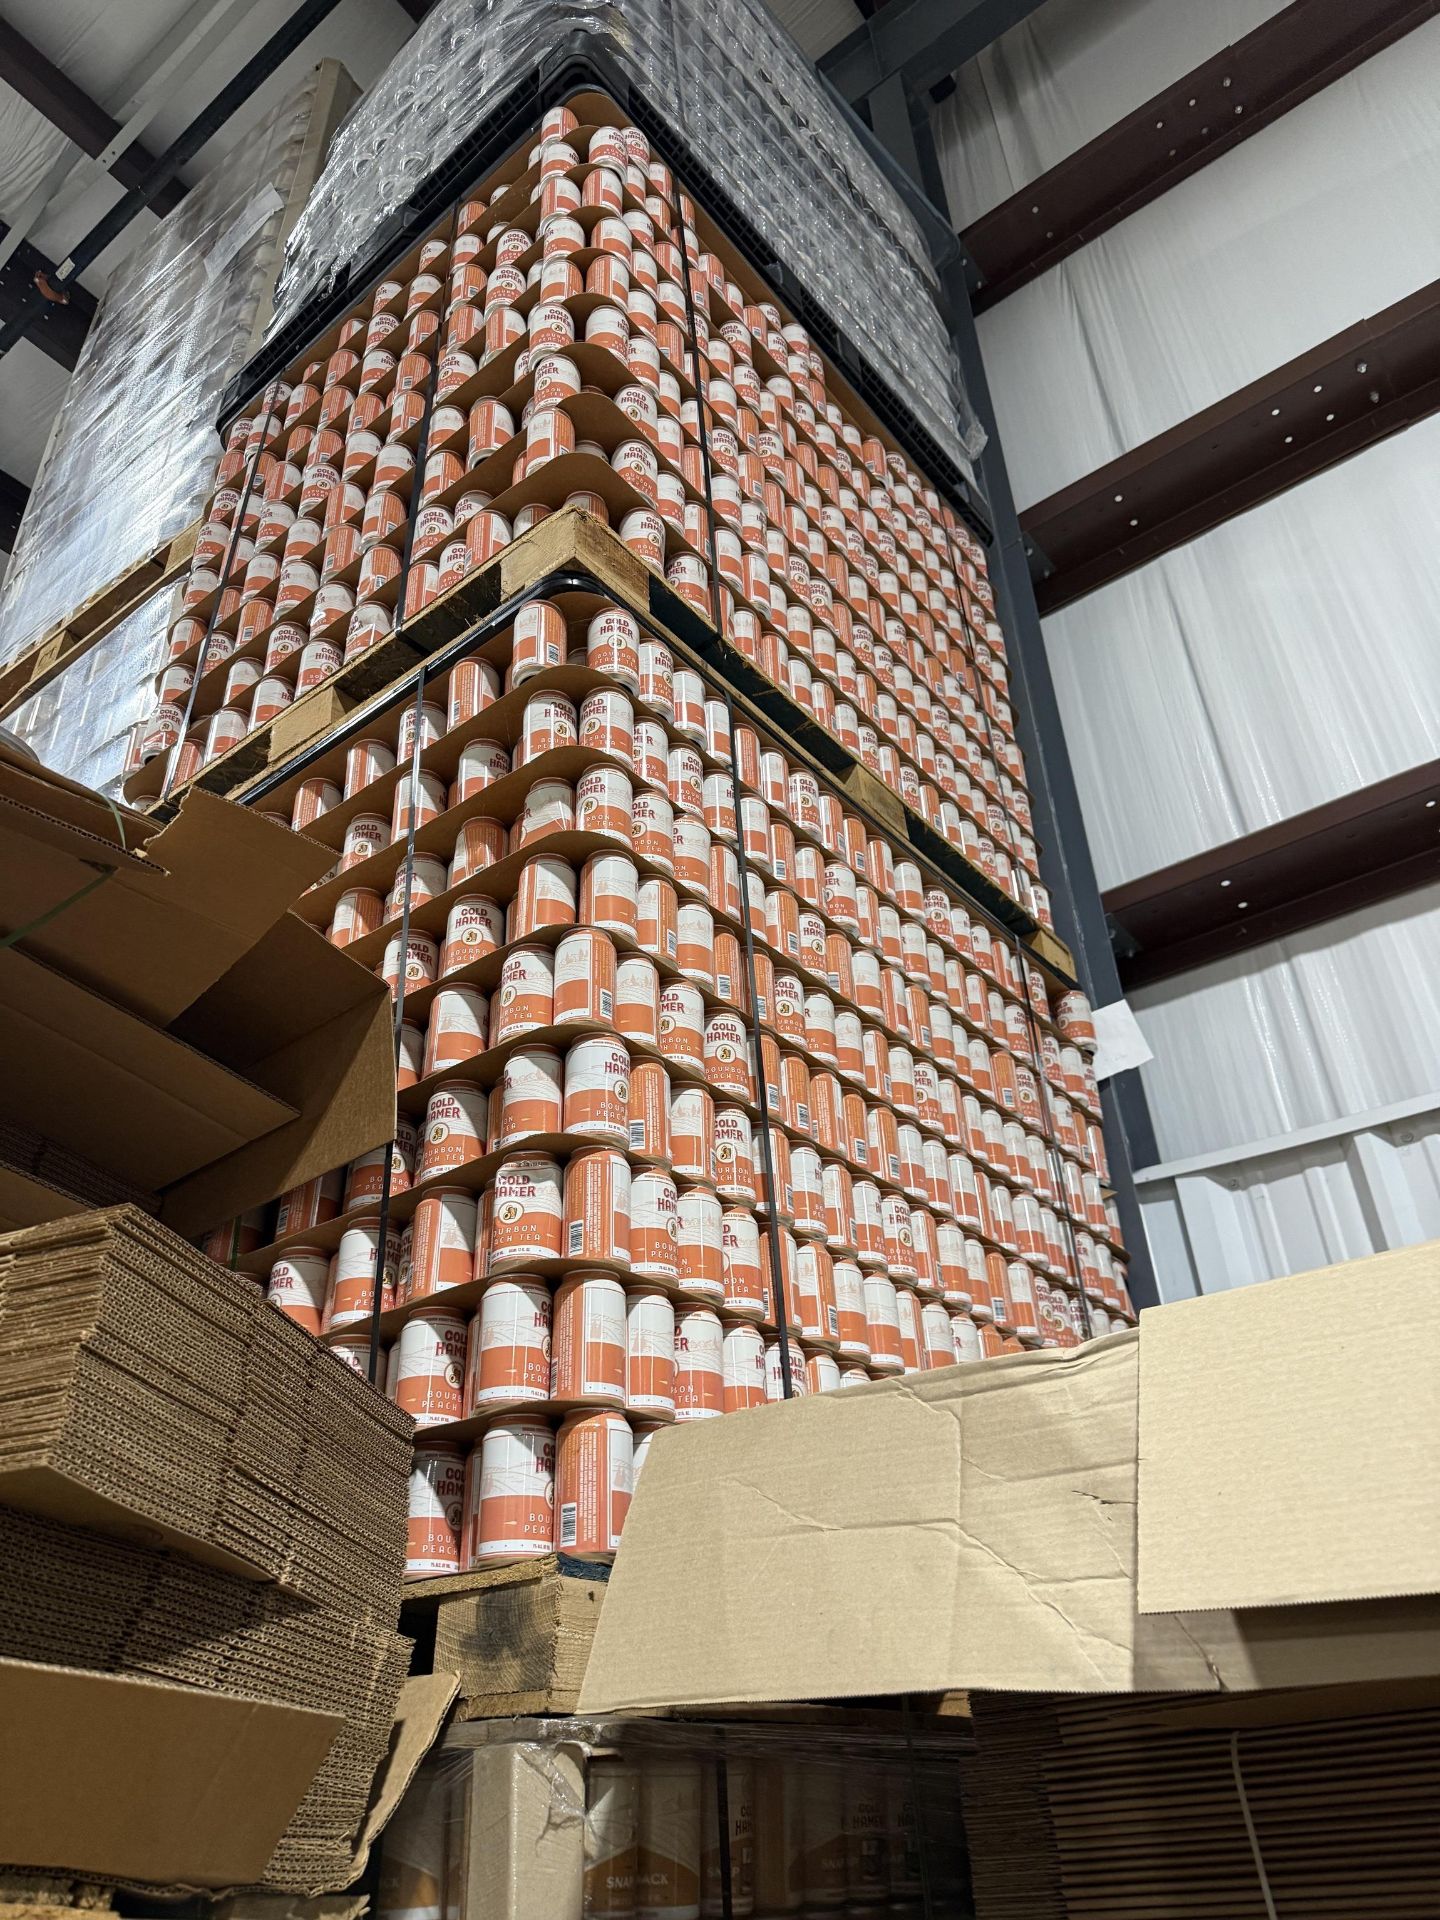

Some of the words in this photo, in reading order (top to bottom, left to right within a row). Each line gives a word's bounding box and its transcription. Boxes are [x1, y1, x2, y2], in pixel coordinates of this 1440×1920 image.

[501, 269, 520, 277] COLD
[496, 275, 523, 285] HAMER
[549, 309, 569, 319] COLD
[627, 392, 646, 402] COLD
[621, 397, 649, 413] HAMER
[629, 447, 650, 458] COLD
[624, 453, 651, 467] HAMER
[312, 473, 338, 483] HAMER
[420, 517, 447, 527] HAMER
[447, 553, 466, 563] HAM
[668, 567, 686, 577] MER
[606, 618, 629, 627] COLD
[600, 626, 633, 638] HAMER
[273, 636, 301, 647] HAMER
[322, 647, 341, 659] COLD
[660, 652, 673, 660] COL
[315, 653, 341, 665] HAME
[655, 657, 673, 667] HAM
[551, 701, 573, 714] COLD
[582, 699, 604, 711] COLD
[545, 709, 576, 721] HAMER
[490, 760, 510, 771] HAM
[688, 756, 702, 766] COL
[682, 762, 703, 774] HAM
[580, 777, 601, 788] COLD
[634, 810, 655, 819] MER
[461, 907, 487, 916] COLD
[455, 916, 492, 928] HAMER
[451, 949, 487, 958] BOURBO
[503, 961, 521, 972] COLD
[661, 1002, 684, 1013] MER
[712, 1023, 737, 1031] COLD
[707, 1032, 742, 1043] HAMER
[604, 1062, 629, 1078] HAME
[915, 1078, 932, 1087] MER
[431, 1098, 454, 1110] COLD
[600, 1102, 625, 1112] BOUR
[428, 1107, 461, 1121] HAMER
[715, 1119, 737, 1128] COLD
[715, 1130, 743, 1141] AMER
[425, 1147, 462, 1158] OURBON
[718, 1166, 748, 1174] URBON
[498, 1175, 530, 1185] COLD
[495, 1186, 536, 1197] HAMER
[658, 1198, 677, 1212] HAM
[889, 1214, 911, 1224] HAME
[493, 1224, 537, 1238] OURBON
[520, 1233, 541, 1241] TEA
[369, 1248, 399, 1264] HME
[651, 1250, 677, 1260] PEAC
[270, 1278, 293, 1288] MER
[445, 1331, 467, 1342] COL
[436, 1342, 466, 1357] HAME
[523, 1373, 550, 1382] PEAC
[773, 1368, 805, 1381] HME
[428, 1391, 462, 1402] BOURB
[678, 1395, 698, 1403] TEA
[422, 1400, 457, 1411] PEACH
[543, 1443, 554, 1456] CO
[446, 1467, 465, 1480] COL
[436, 1481, 464, 1495] HAM
[524, 1524, 551, 1534] PEAC
